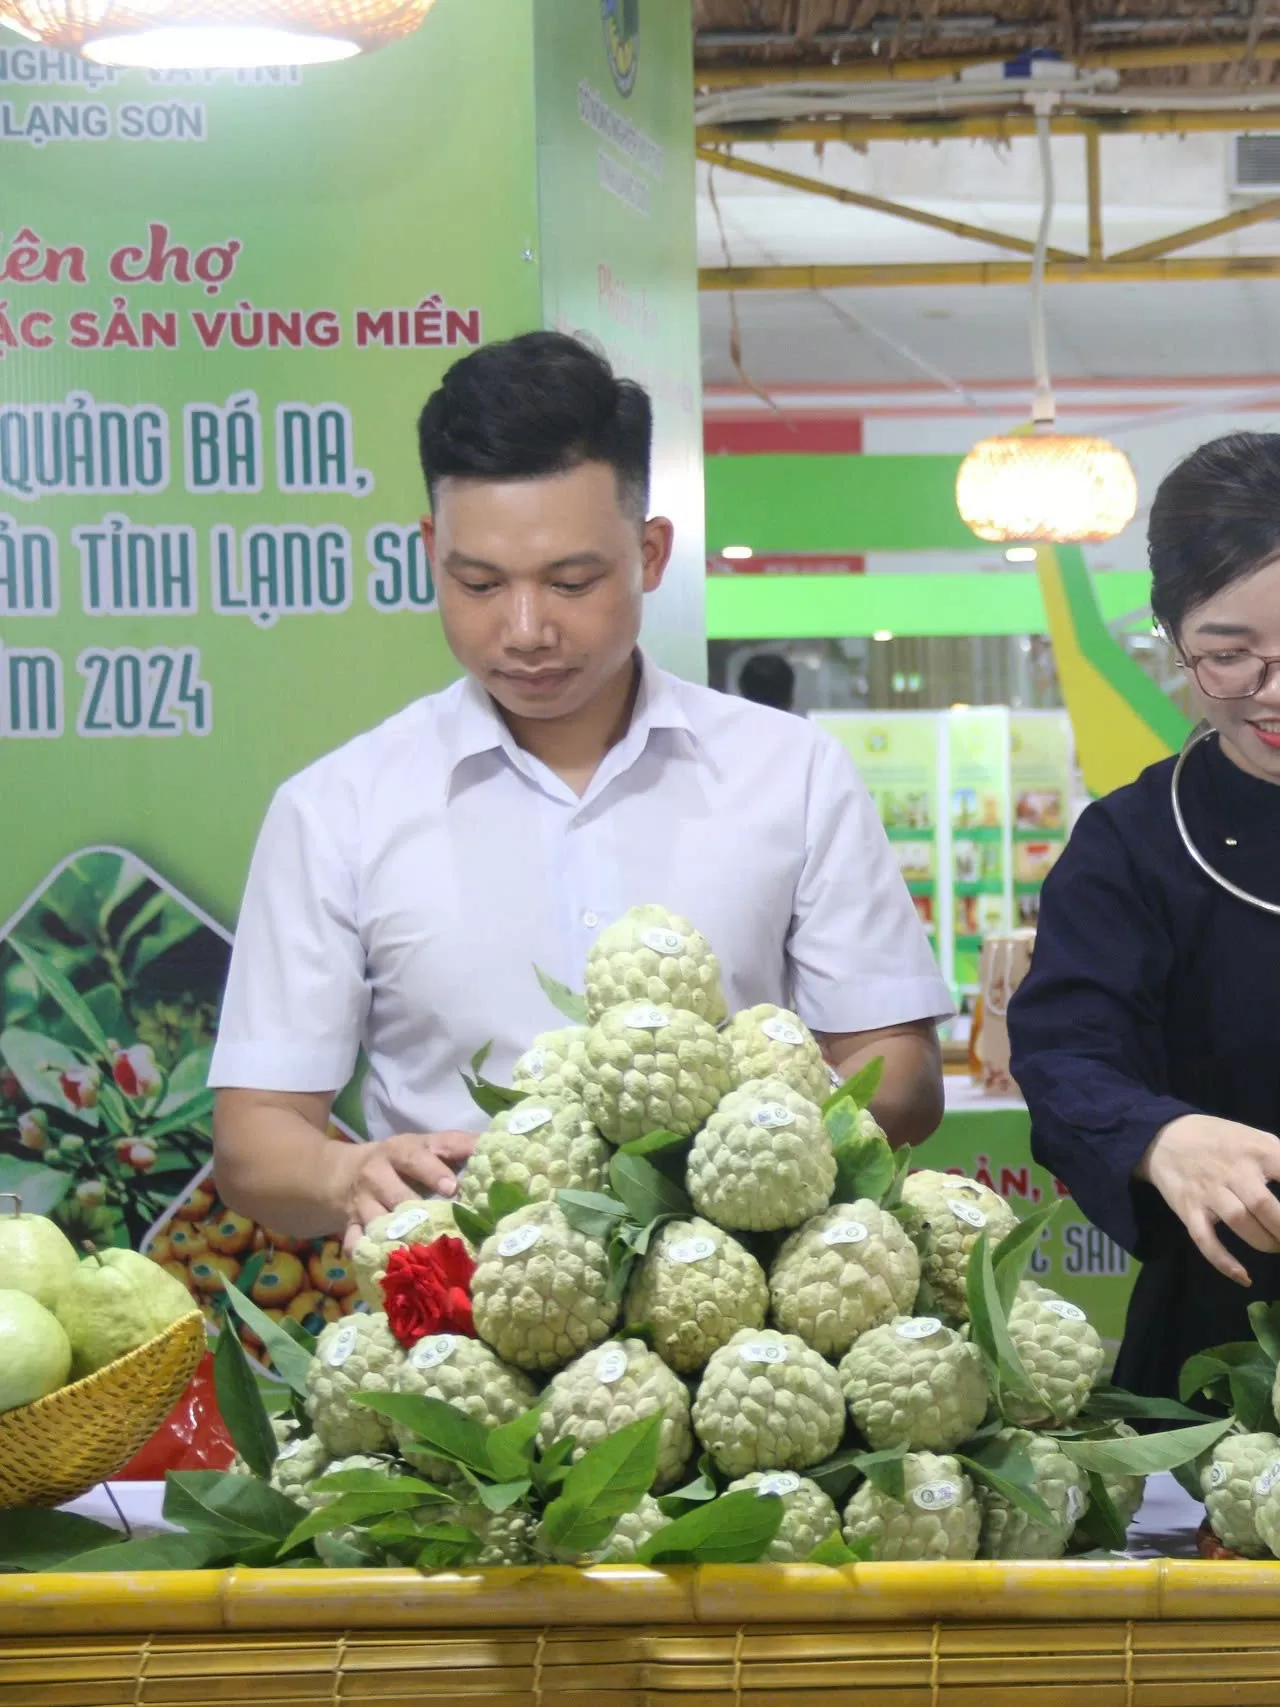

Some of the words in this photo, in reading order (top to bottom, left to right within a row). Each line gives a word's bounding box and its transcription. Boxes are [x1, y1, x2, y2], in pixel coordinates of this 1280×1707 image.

[3, 104, 108, 143] LẠNG
[120, 102, 202, 137] SƠN
[0, 228, 87, 283] ên
[110, 223, 241, 294] chợ
[69, 297, 176, 347] SẢN
[192, 302, 340, 347] VÙNG
[356, 295, 479, 346] MIỀN
[1, 398, 163, 493] QUẢNG
[191, 398, 255, 487] BÁ
[79, 519, 191, 609] TỈNH
[218, 531, 346, 621] LẠNG
[84, 653, 205, 730] 2024
[947, 1155, 1042, 1203] ẢN,
